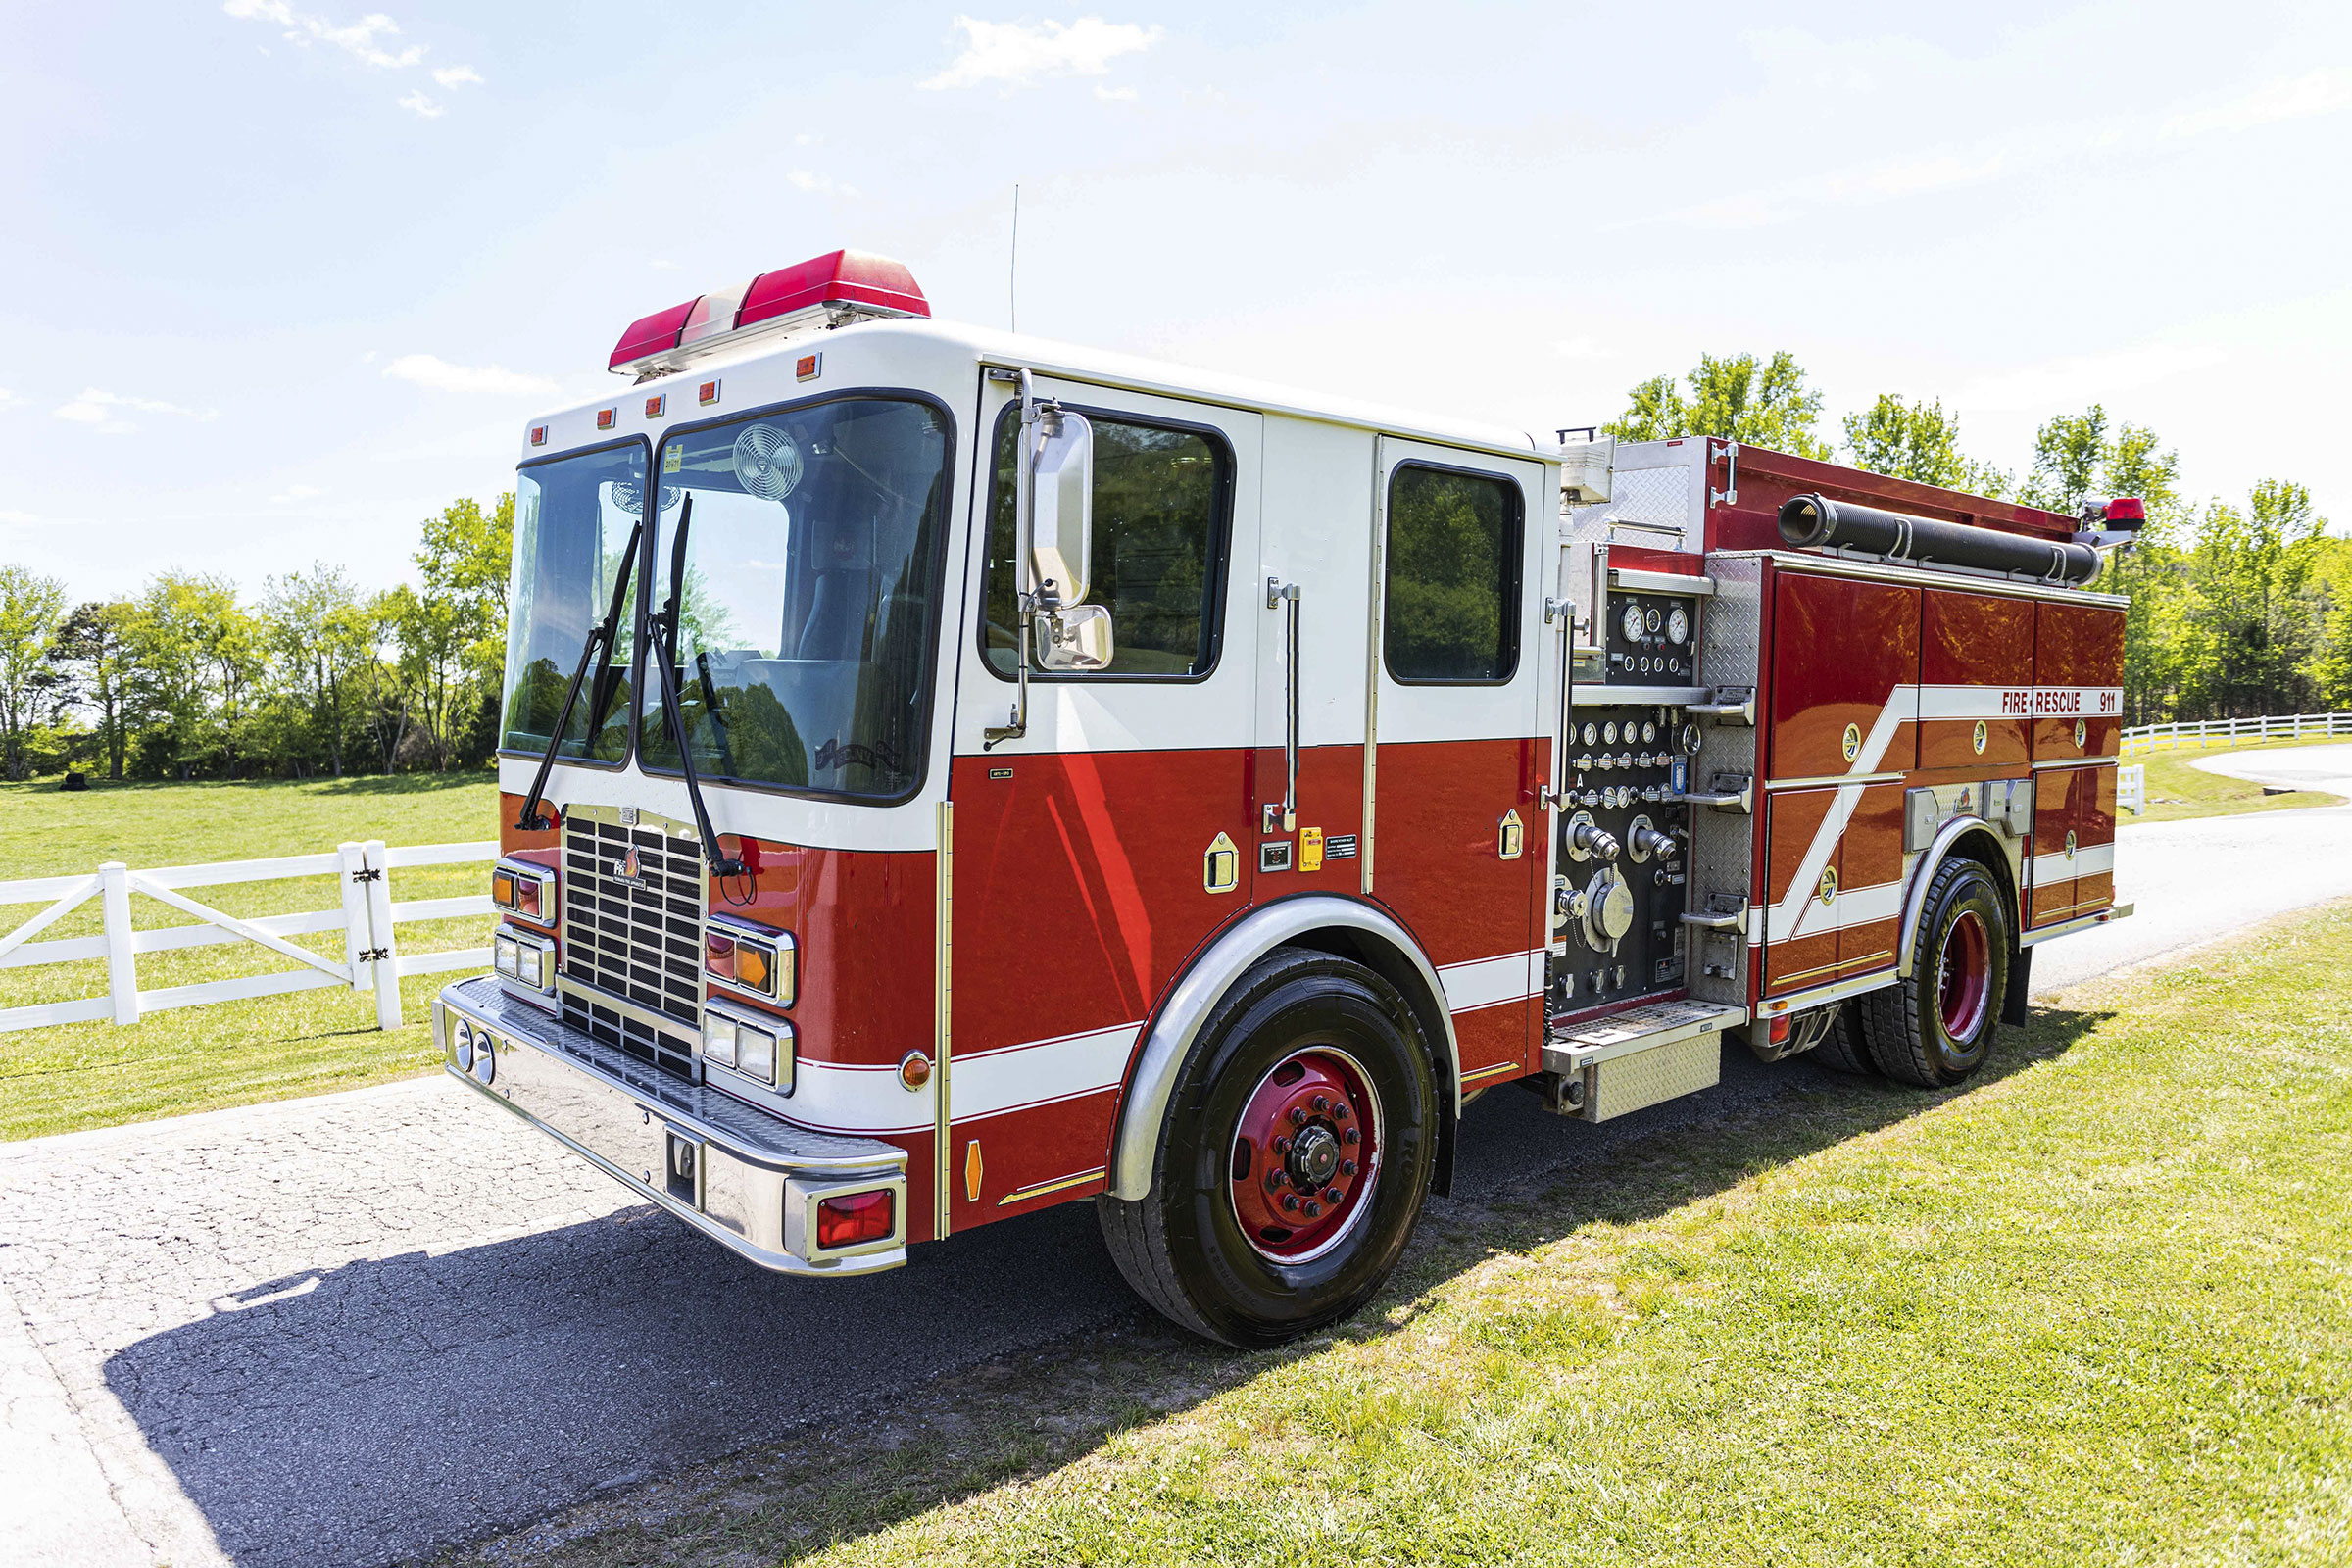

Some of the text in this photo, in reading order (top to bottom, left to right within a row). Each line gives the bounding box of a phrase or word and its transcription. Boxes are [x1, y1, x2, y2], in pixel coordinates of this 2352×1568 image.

[2002, 691, 2115, 713] FIRE RESCUE 911
[1577, 773, 1583, 788] A
